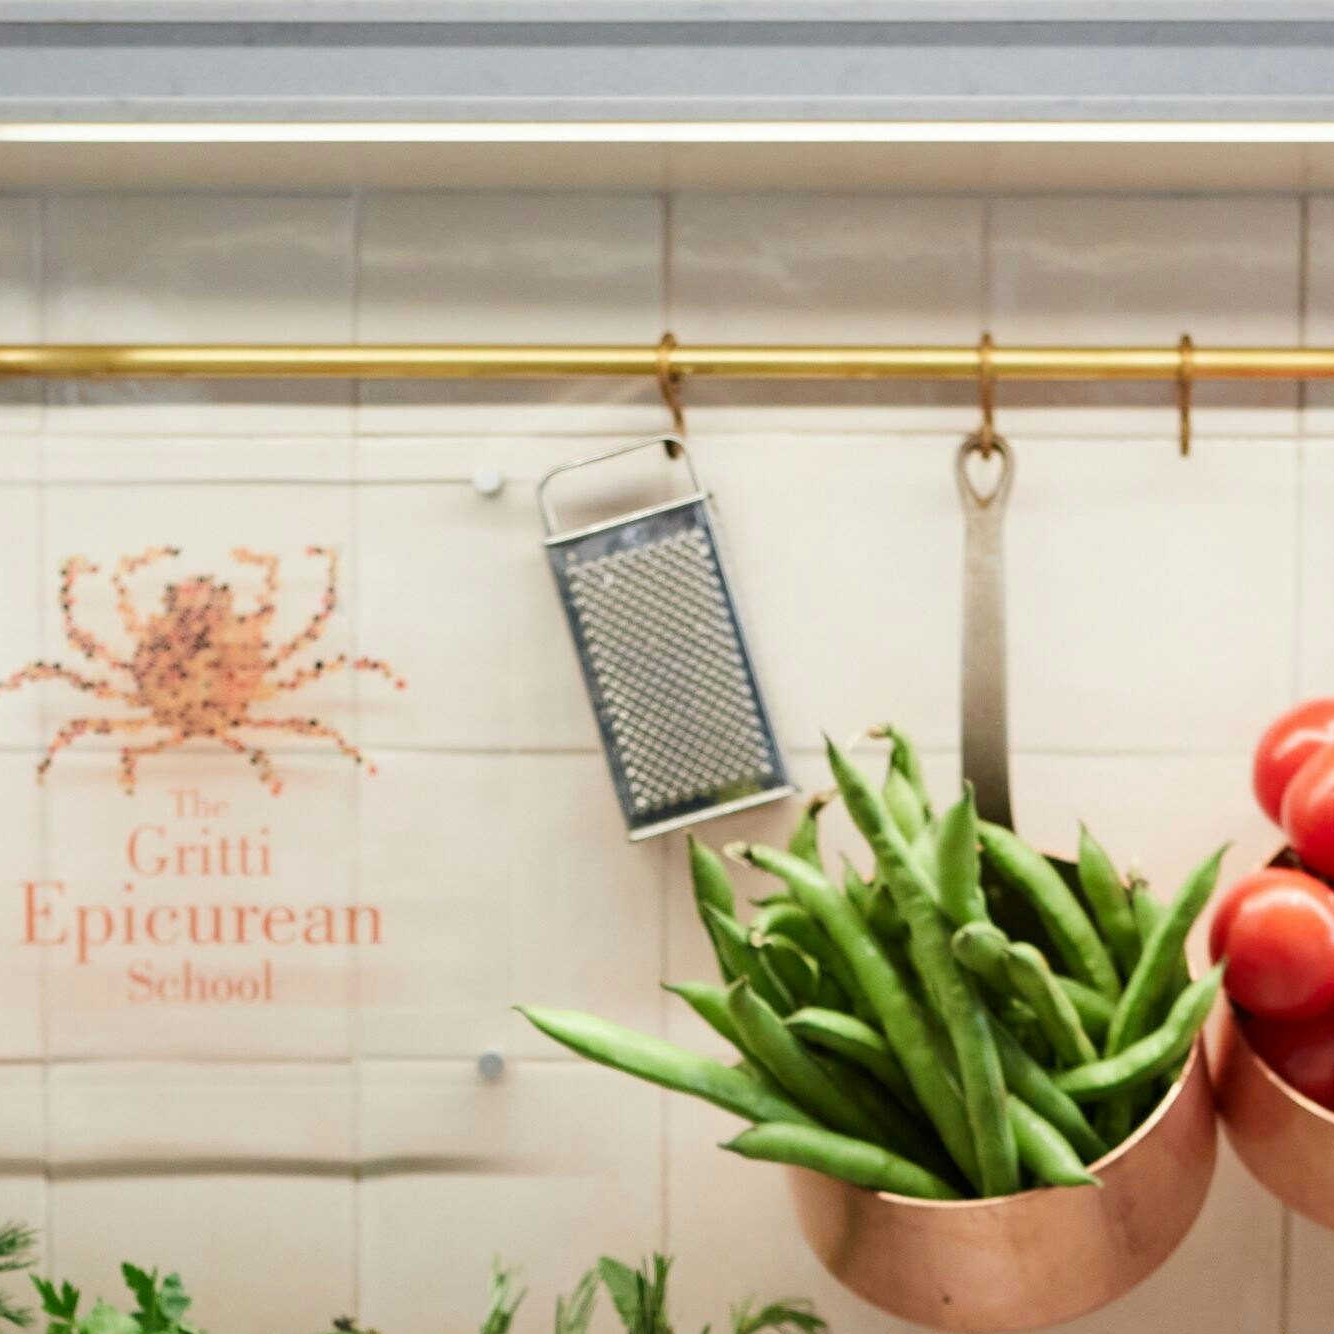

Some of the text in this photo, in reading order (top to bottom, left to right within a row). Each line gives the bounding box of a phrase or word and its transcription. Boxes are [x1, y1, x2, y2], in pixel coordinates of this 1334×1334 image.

[168, 788, 228, 819] The
[127, 826, 273, 877] Gritti
[18, 880, 383, 965] Epicurean
[127, 959, 275, 1003] School
